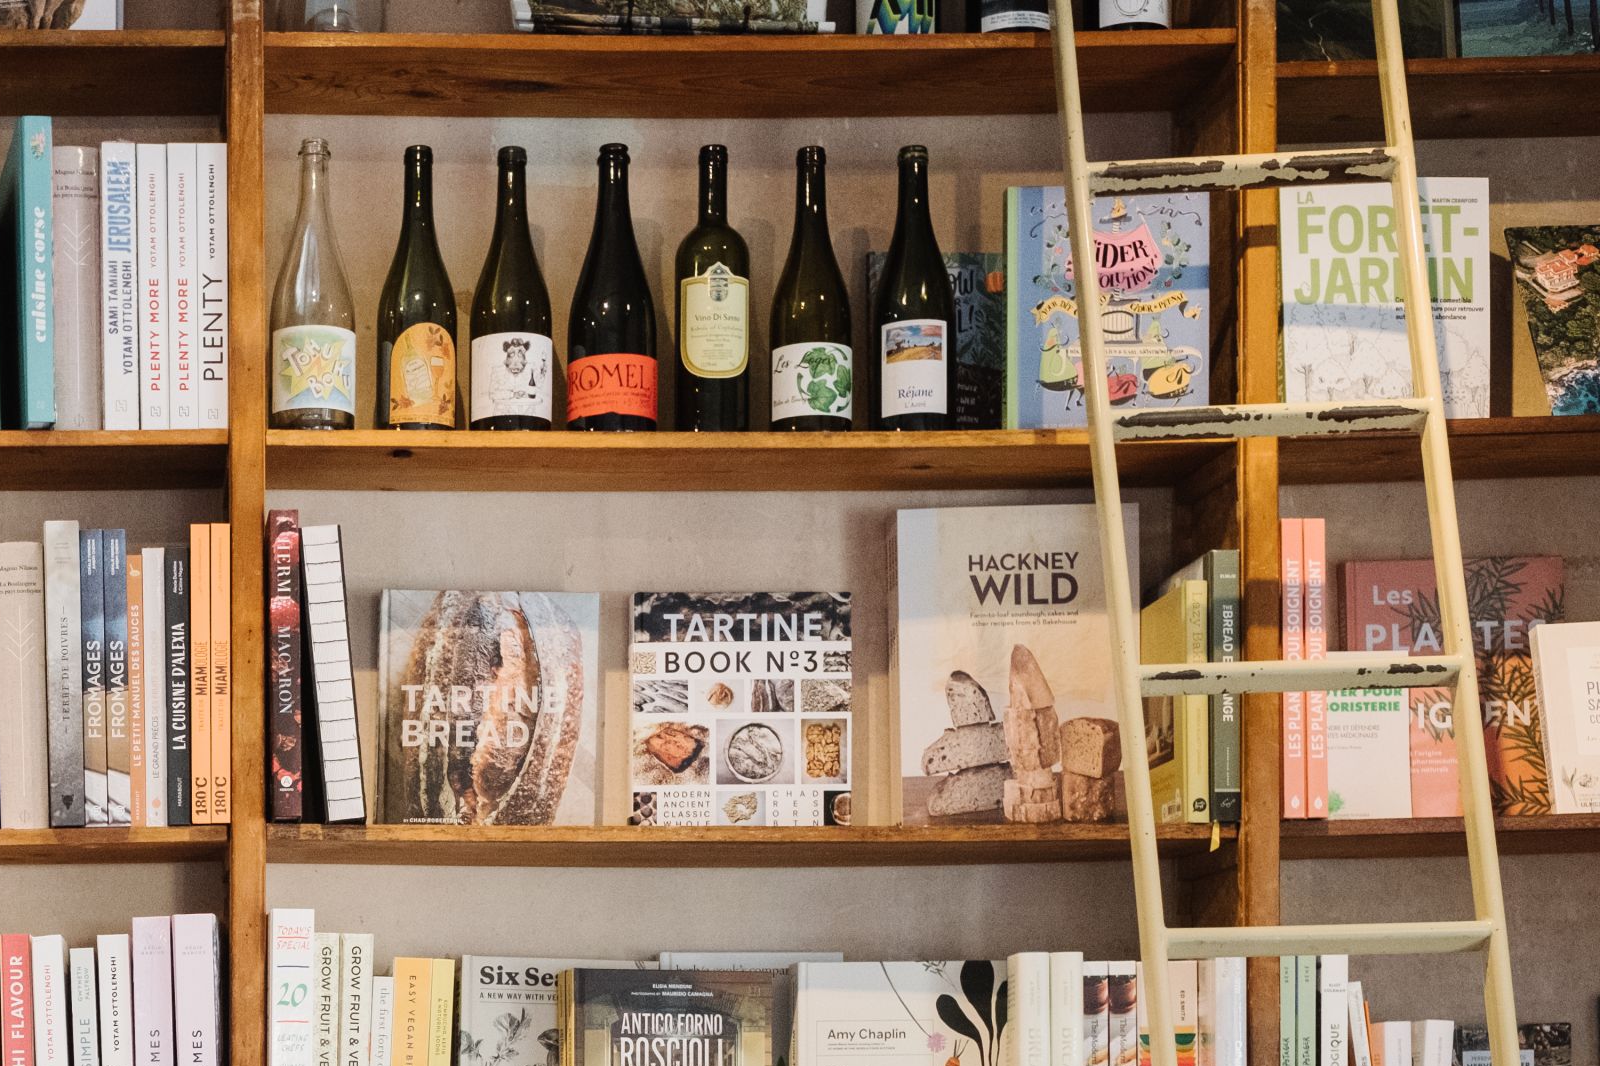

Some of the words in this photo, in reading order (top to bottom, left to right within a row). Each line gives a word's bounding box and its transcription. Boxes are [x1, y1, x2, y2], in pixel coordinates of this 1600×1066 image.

[1297, 191, 1315, 205] LA
[34, 206, 46, 263] corse
[149, 278, 159, 323] MORE
[203, 273, 223, 381] PLENTY
[151, 330, 160, 391] PLENTY
[898, 386, 934, 399] Réjane
[969, 552, 1079, 572] HACKNEY
[970, 572, 1079, 606] WILD
[664, 613, 823, 642] TARTINE
[664, 650, 752, 674] BOOK
[402, 685, 567, 714] TARTINE
[402, 720, 530, 748] BREAD
[351, 946, 362, 989] GROW
[480, 965, 520, 986] Six
[9, 954, 25, 1040] FLAVOUR
[350, 994, 361, 1033] FRUIT
[621, 1012, 673, 1036] ANTICO
[677, 1013, 723, 1036] FORNO
[350, 1037, 358, 1046] &
[827, 1029, 855, 1042] Amy
[858, 1027, 907, 1042] Chaplin
